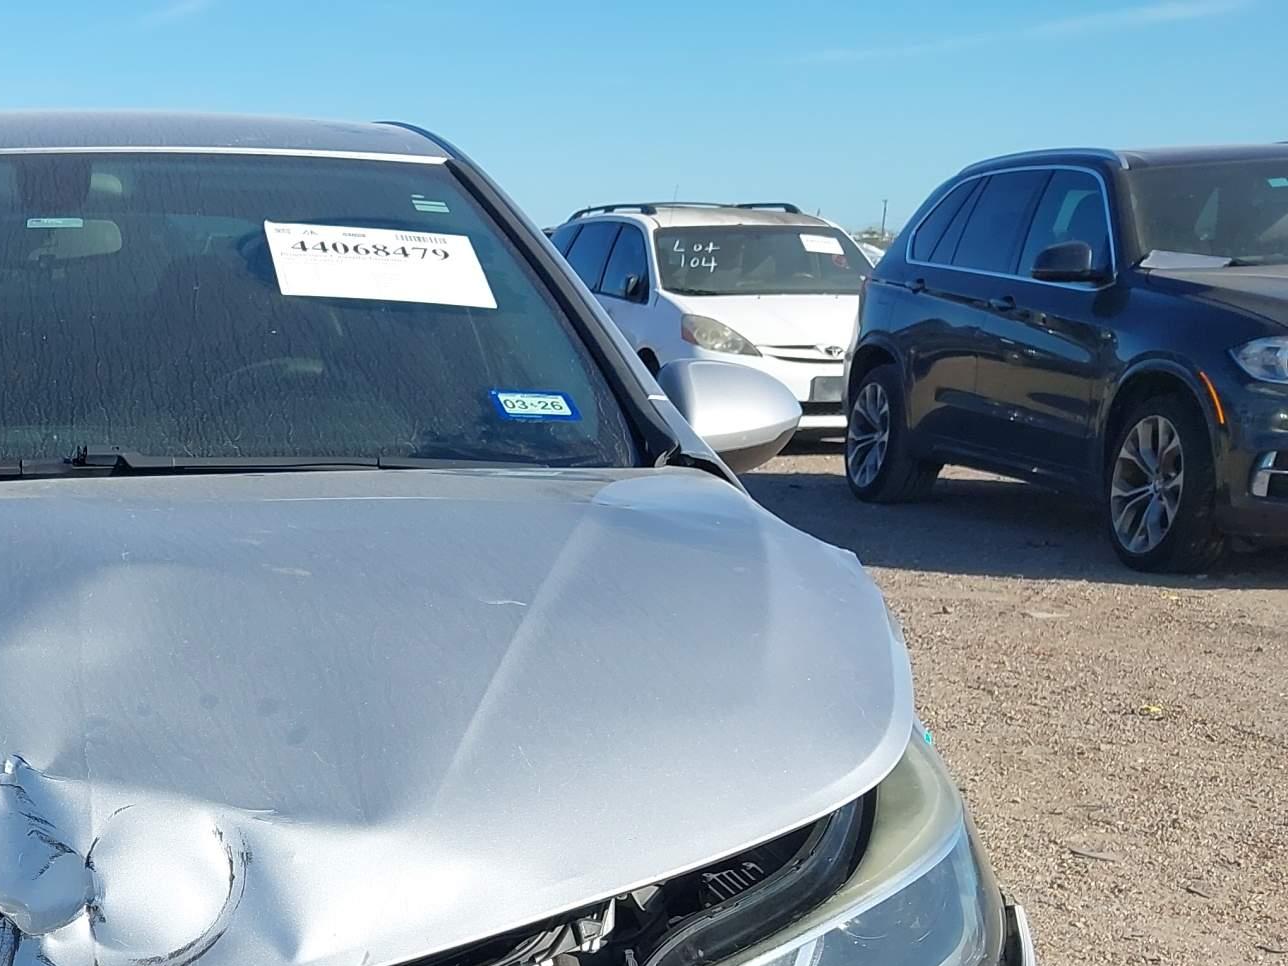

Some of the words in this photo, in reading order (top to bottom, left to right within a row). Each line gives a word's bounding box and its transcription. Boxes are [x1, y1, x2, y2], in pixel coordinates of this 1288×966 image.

[291, 240, 450, 260] 44068479
[674, 239, 720, 252] Lot
[680, 254, 718, 273] 104
